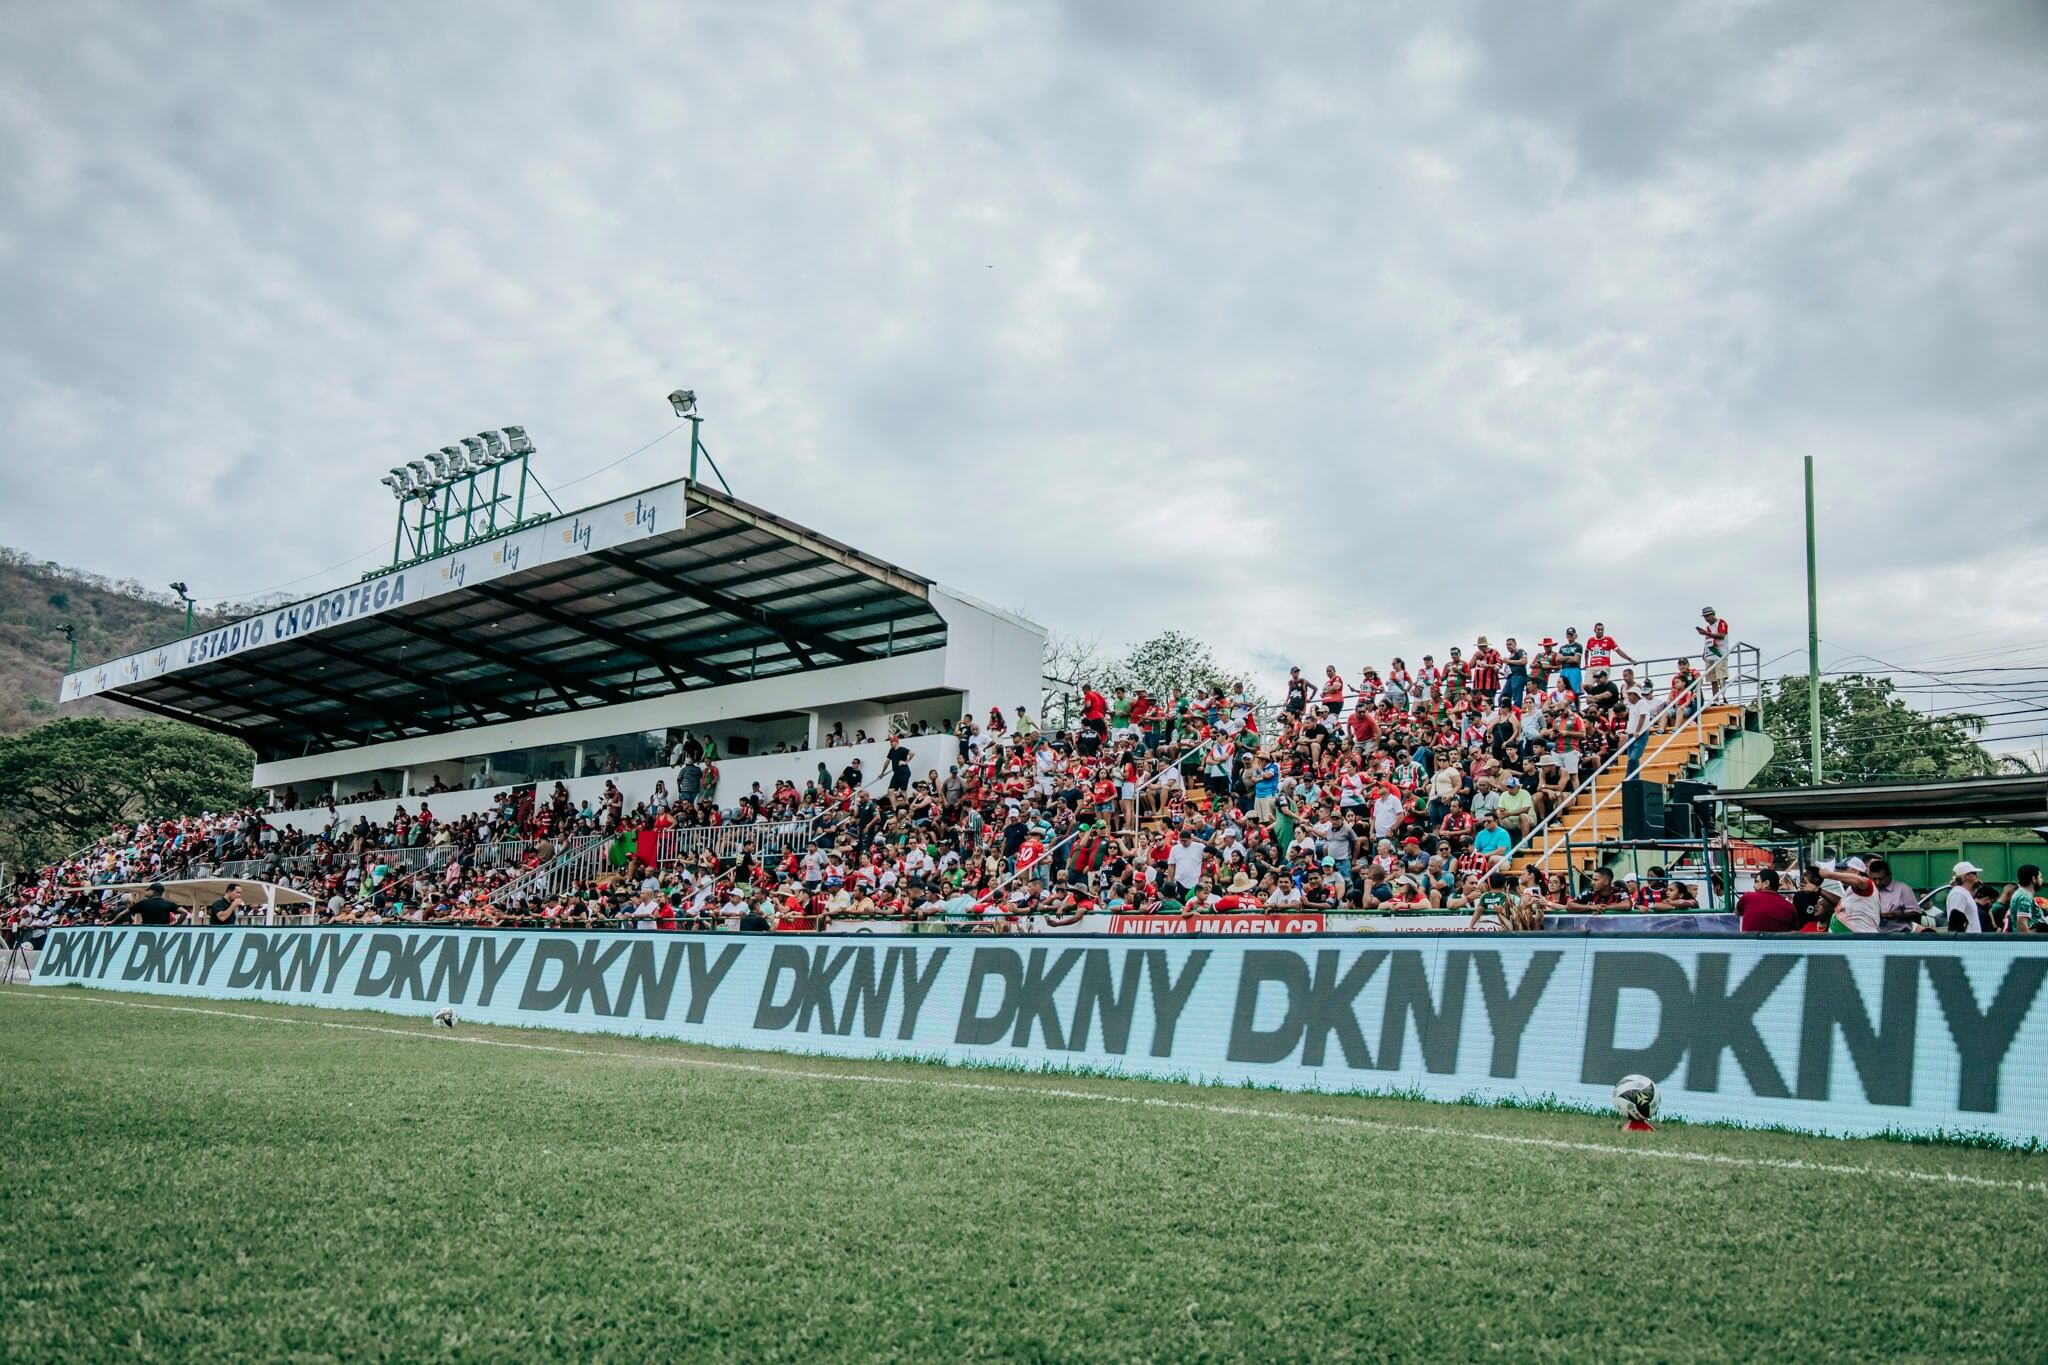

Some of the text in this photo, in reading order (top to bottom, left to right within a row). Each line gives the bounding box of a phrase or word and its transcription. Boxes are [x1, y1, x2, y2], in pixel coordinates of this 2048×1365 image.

[636, 499, 656, 534] tig
[572, 518, 593, 551] tig
[502, 539, 520, 570] tig
[449, 557, 465, 587] tig
[187, 574, 405, 664] ESTADIO CHOROTEGA
[1122, 919, 1318, 934] NUEVA IMAGEN CR
[39, 931, 2048, 1113] DKNY DKNY DKNY DKNY DKNY DKNY DKNY DKNY DKNY
